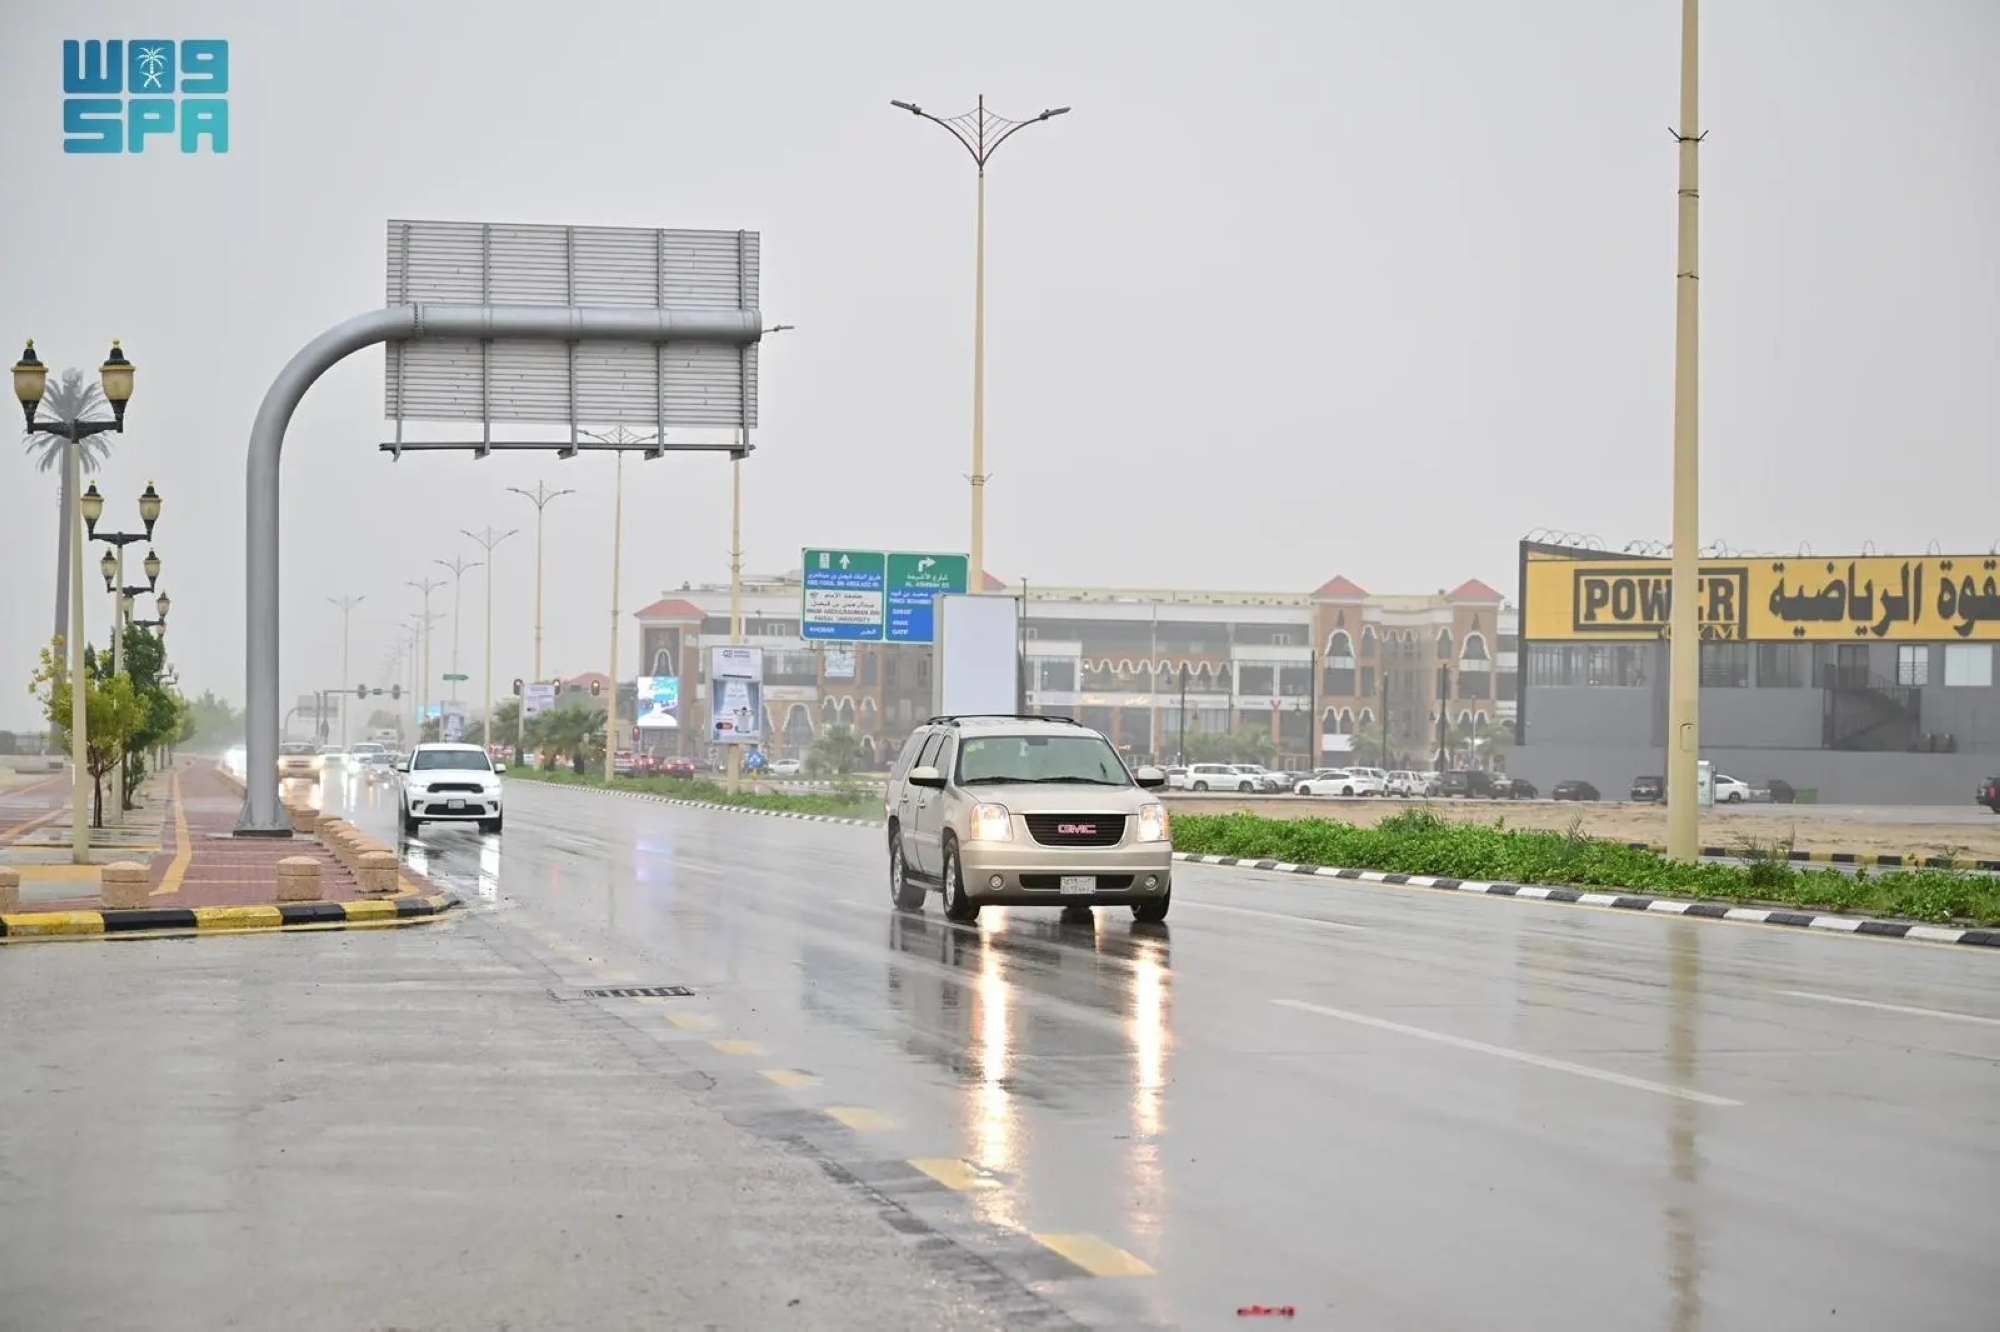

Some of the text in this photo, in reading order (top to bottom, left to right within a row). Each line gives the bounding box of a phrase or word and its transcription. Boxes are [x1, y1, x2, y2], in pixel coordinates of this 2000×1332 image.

[1584, 578, 1735, 621] POWR
[1769, 561, 1923, 637] الرياضية
[1058, 824, 1097, 835] GMC
